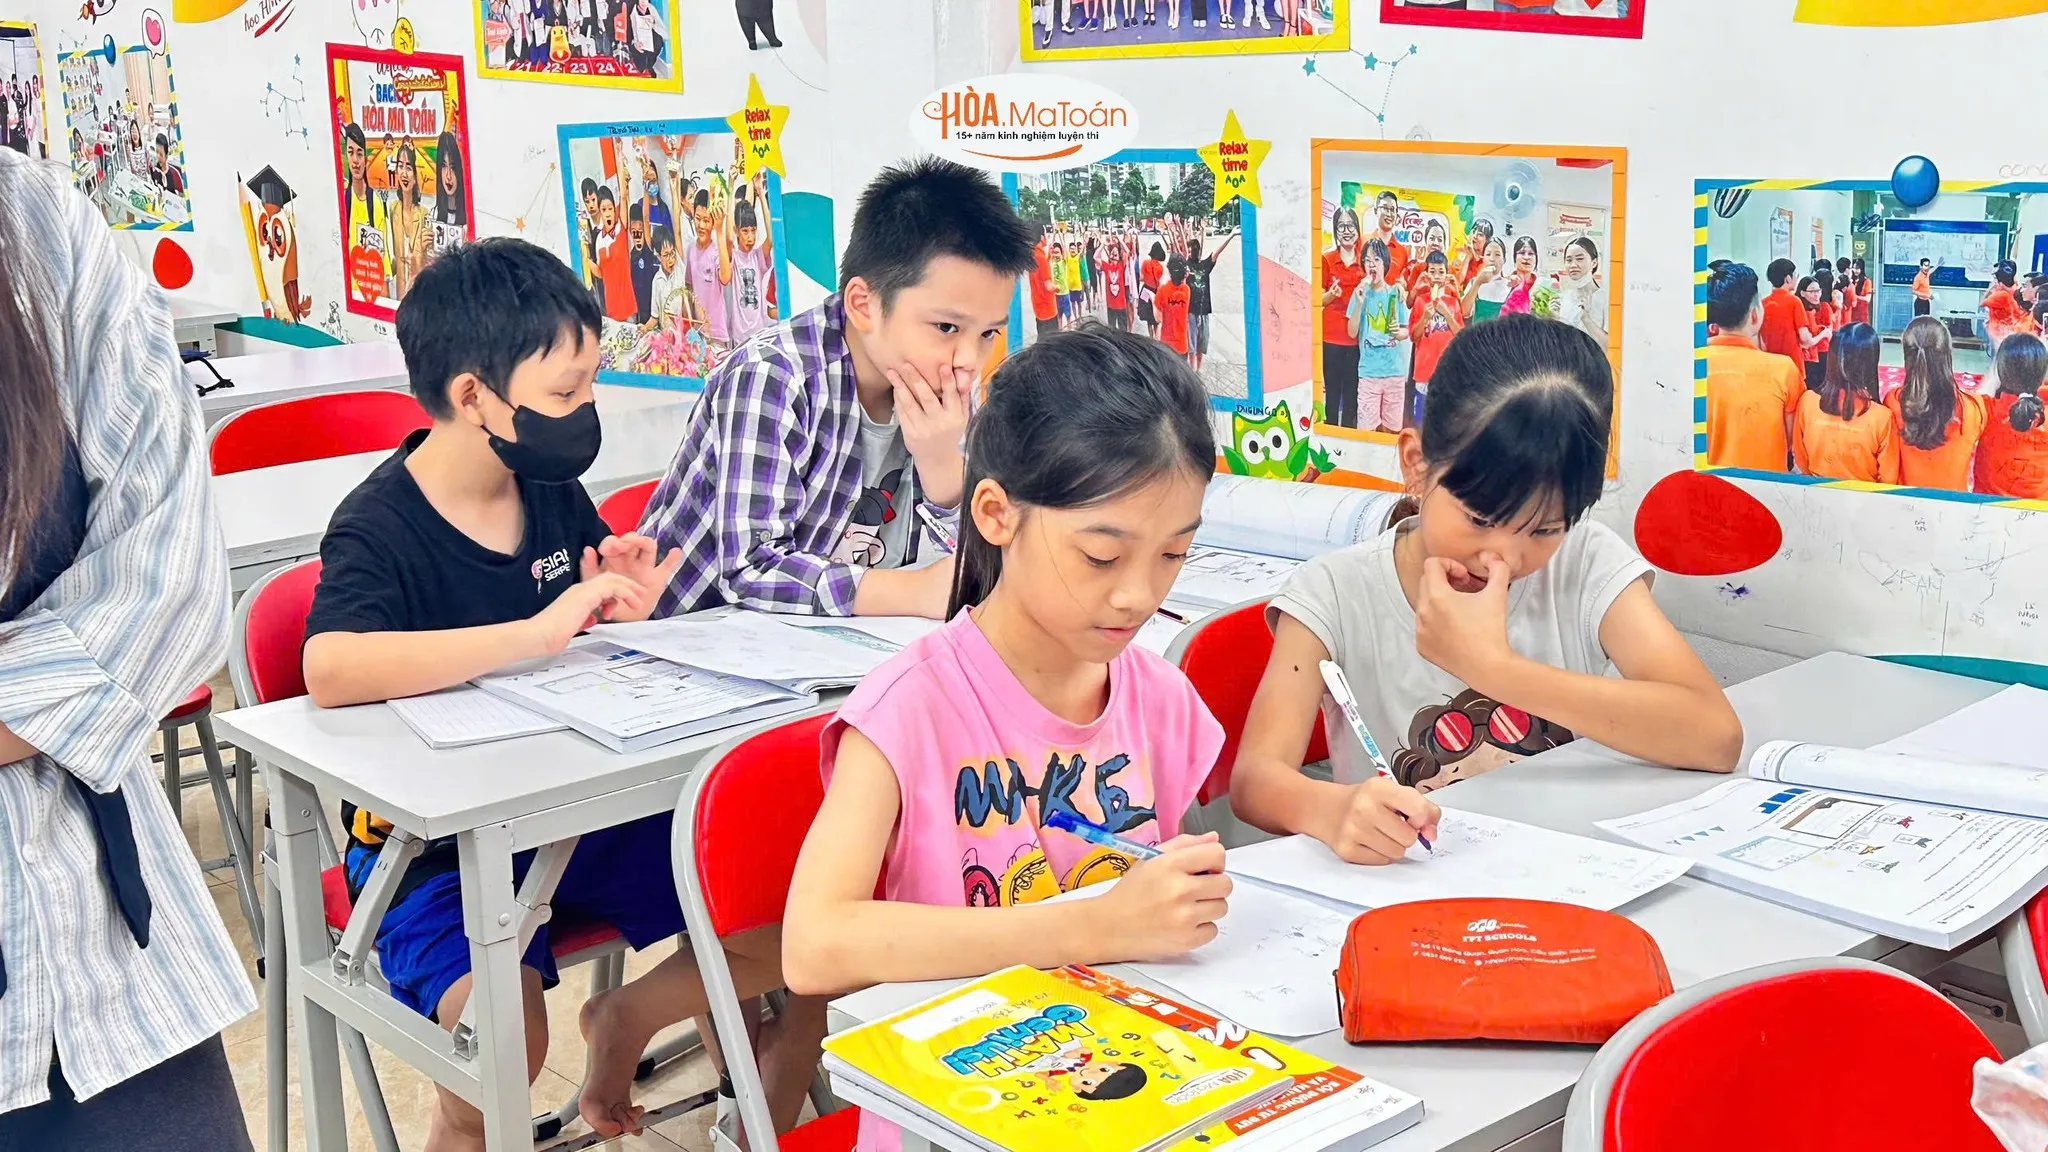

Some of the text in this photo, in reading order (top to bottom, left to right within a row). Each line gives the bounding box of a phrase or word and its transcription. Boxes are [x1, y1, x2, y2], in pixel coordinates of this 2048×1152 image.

[570, 63, 588, 74] 23
[596, 63, 615, 74] 24
[376, 83, 399, 103] BAC
[387, 107, 406, 134] MA
[744, 109, 771, 124] Relax
[748, 126, 771, 141] time
[1219, 141, 1249, 156] Relax
[1222, 157, 1248, 172] time
[941, 1004, 1087, 1075] Genius!
[973, 1021, 1095, 1077] MATH
[1234, 1116, 1259, 1130] DUY
